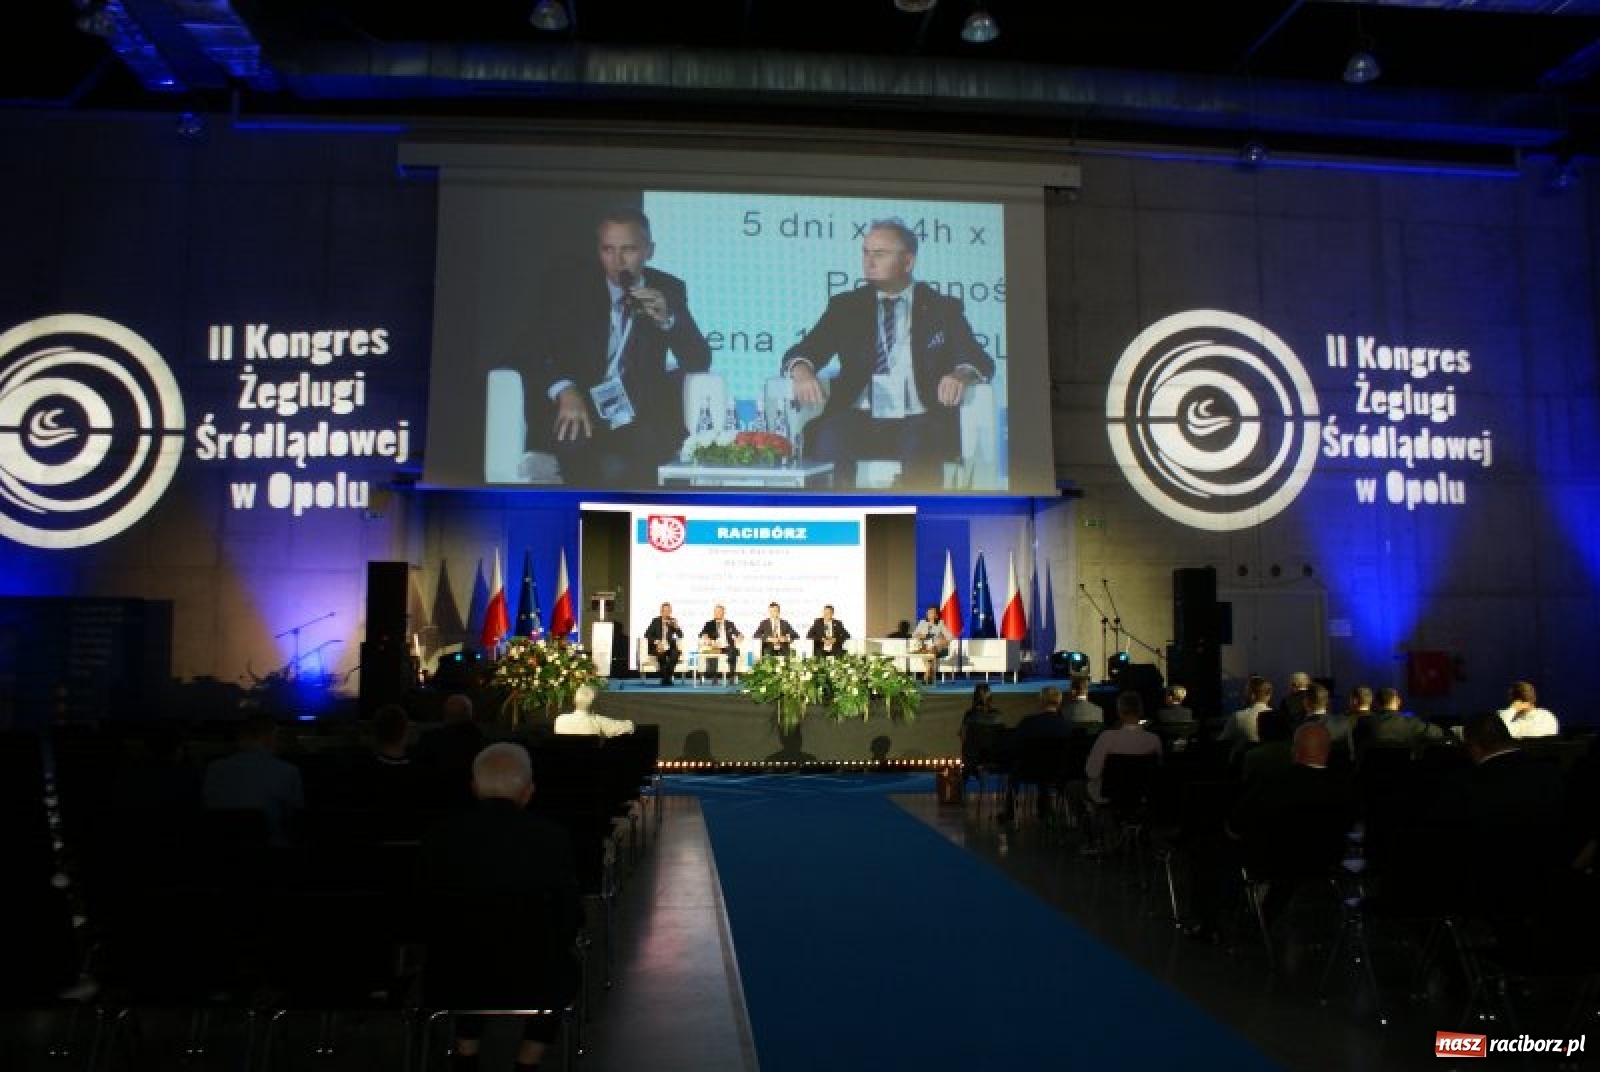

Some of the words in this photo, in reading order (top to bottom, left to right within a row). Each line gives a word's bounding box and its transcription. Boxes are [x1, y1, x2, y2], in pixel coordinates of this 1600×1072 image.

[742, 211, 762, 237] 5
[779, 212, 834, 239] dni
[851, 221, 868, 241] x
[969, 225, 986, 245] x
[208, 324, 234, 361] II
[244, 324, 391, 366] Kongres
[706, 330, 773, 353] ena
[1326, 334, 1348, 368] II
[1356, 335, 1472, 379] Kongres
[238, 364, 366, 416] Żeglugi
[1354, 372, 1457, 423] Żeglugi
[196, 412, 411, 468] Śródlądowej
[1322, 413, 1493, 469] Śródlądowej
[229, 481, 258, 510] w
[267, 471, 370, 517] Opolu
[1355, 478, 1378, 504] w
[1385, 470, 1467, 511] Opolu
[717, 526, 807, 539] RACIBÓRZ
